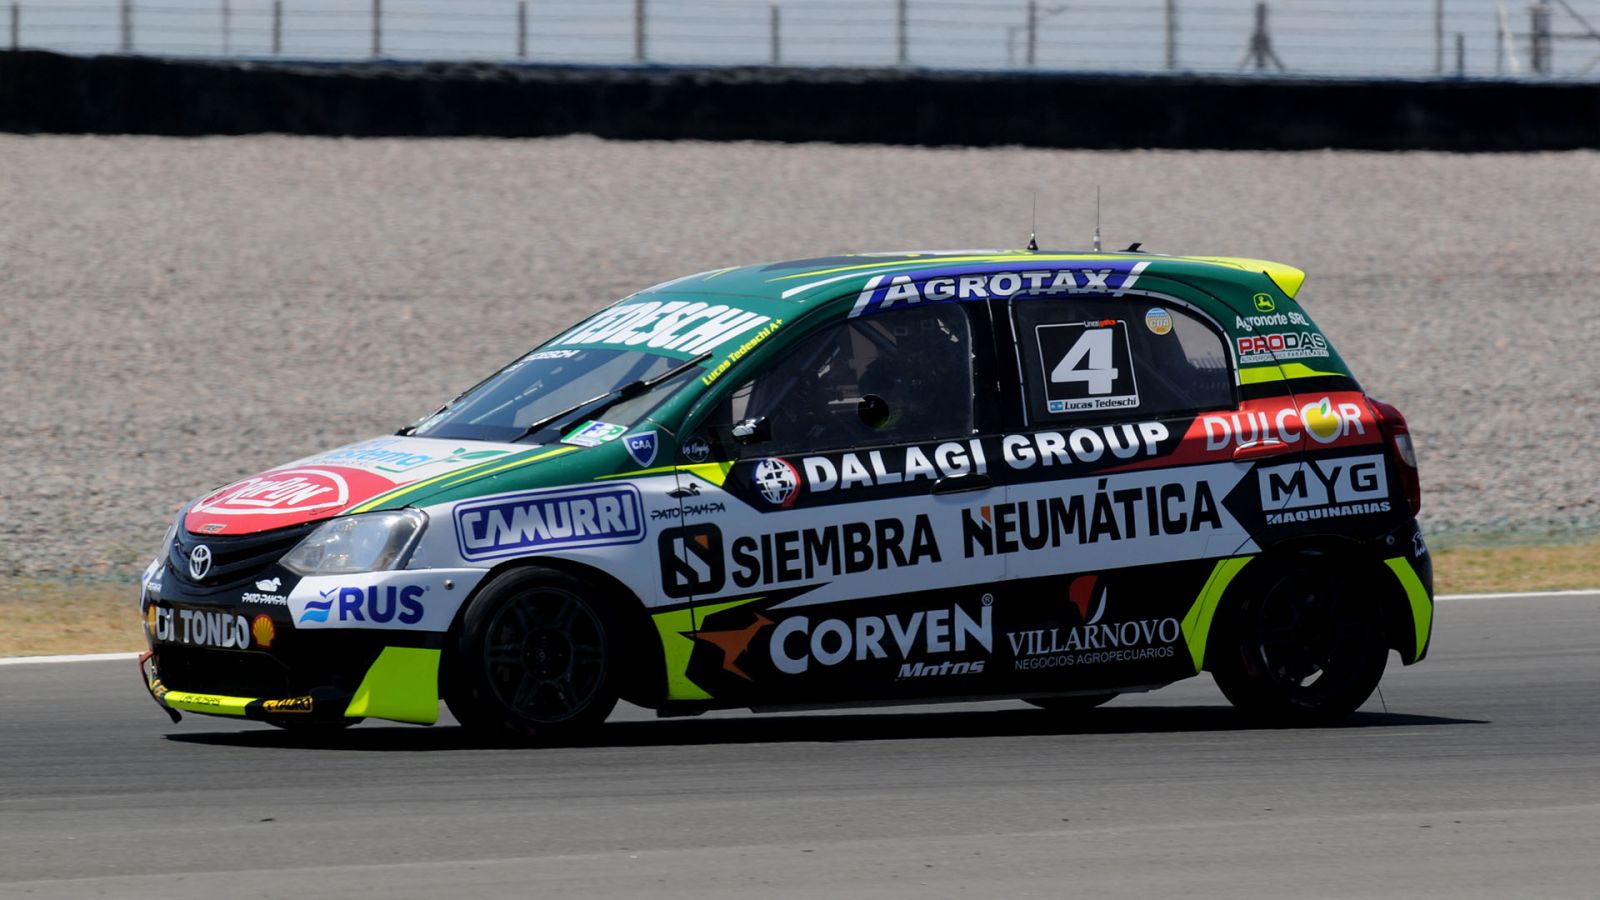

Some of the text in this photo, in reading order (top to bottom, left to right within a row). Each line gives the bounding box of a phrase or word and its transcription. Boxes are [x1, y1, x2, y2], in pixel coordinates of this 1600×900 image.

[880, 269, 1112, 308] AGROTAX
[547, 301, 772, 355] TEDESCHI
[1236, 312, 1309, 332] Agronorte SRL
[1238, 332, 1327, 355] PRODAS
[702, 360, 731, 386] Lucas
[728, 327, 771, 362] Tedeschi
[1051, 328, 1118, 395] 4
[1065, 397, 1136, 410] Lucas Tedeschi
[1203, 397, 1365, 451] DULCOR
[632, 440, 652, 450] CAA
[802, 421, 1170, 493] DALAGI GROUP
[1268, 458, 1379, 507] MYG
[461, 494, 637, 550] CAMURRI
[731, 478, 1223, 588] SIEMBRA NEUMÁTICA
[1266, 501, 1391, 525] MAQUINARIAS
[156, 605, 250, 650] DI TONDO
[339, 585, 425, 625] RUS
[769, 603, 993, 675] CORVEN
[1006, 617, 1180, 656] VILLARNOVO
[1015, 646, 1175, 671] NEGOCIOS AGROPECUARIOS
